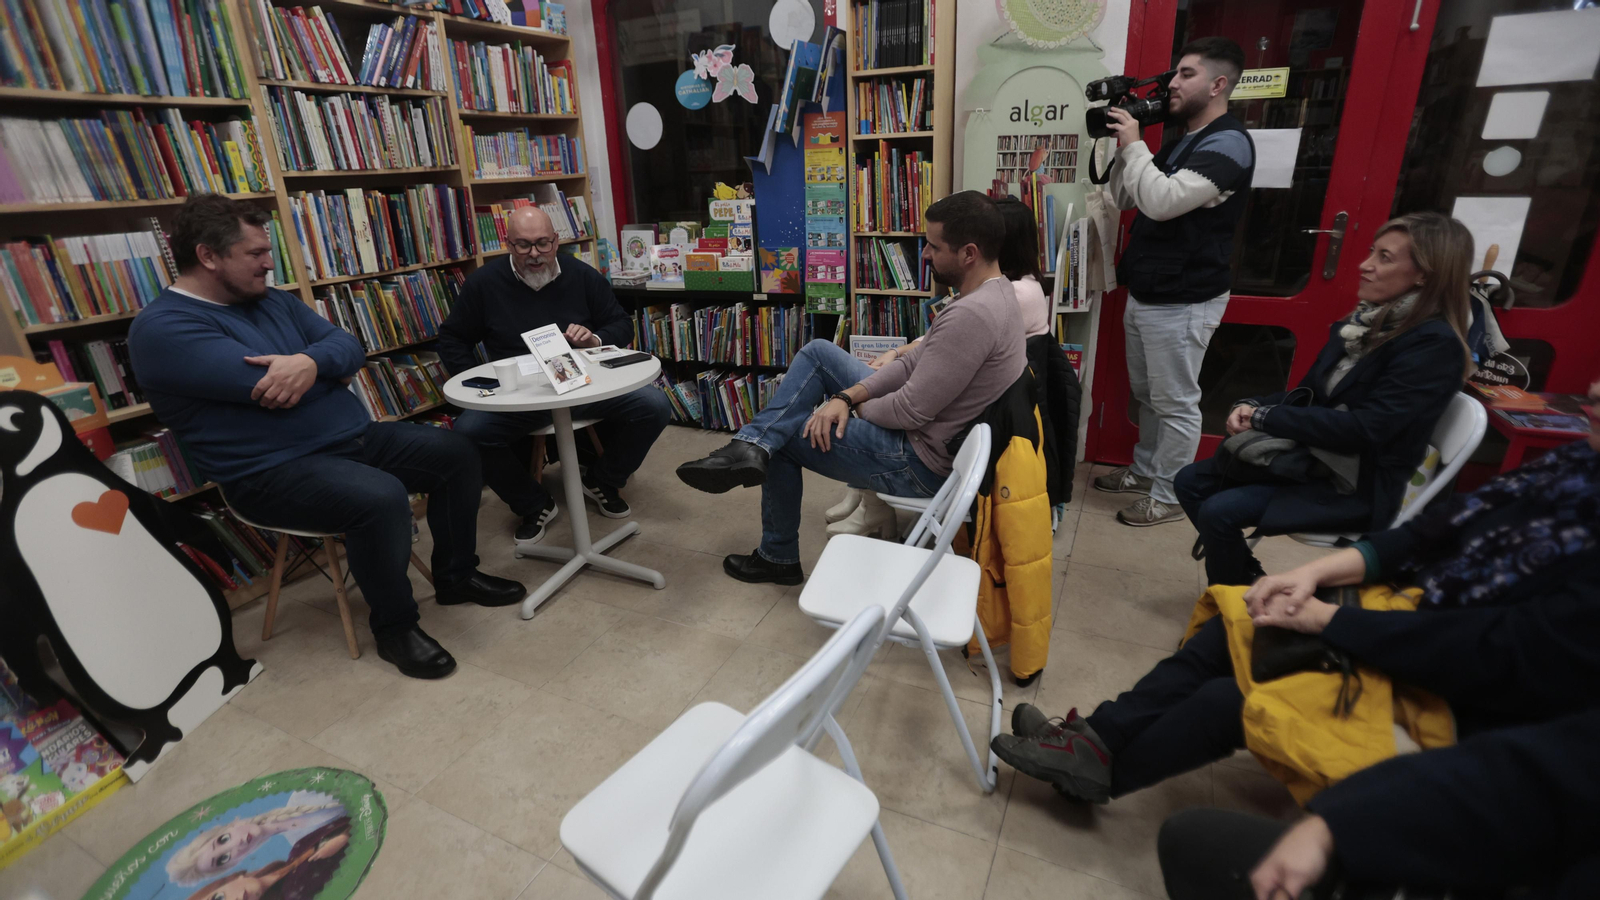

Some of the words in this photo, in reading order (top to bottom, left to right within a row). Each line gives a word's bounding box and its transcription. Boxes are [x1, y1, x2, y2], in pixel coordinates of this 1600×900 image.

[1009, 99, 1069, 128] algar
[713, 208, 734, 217] PEPE
[531, 331, 557, 343] Demonios
[41, 723, 87, 758] NDARIOS
[148, 828, 179, 854] con
